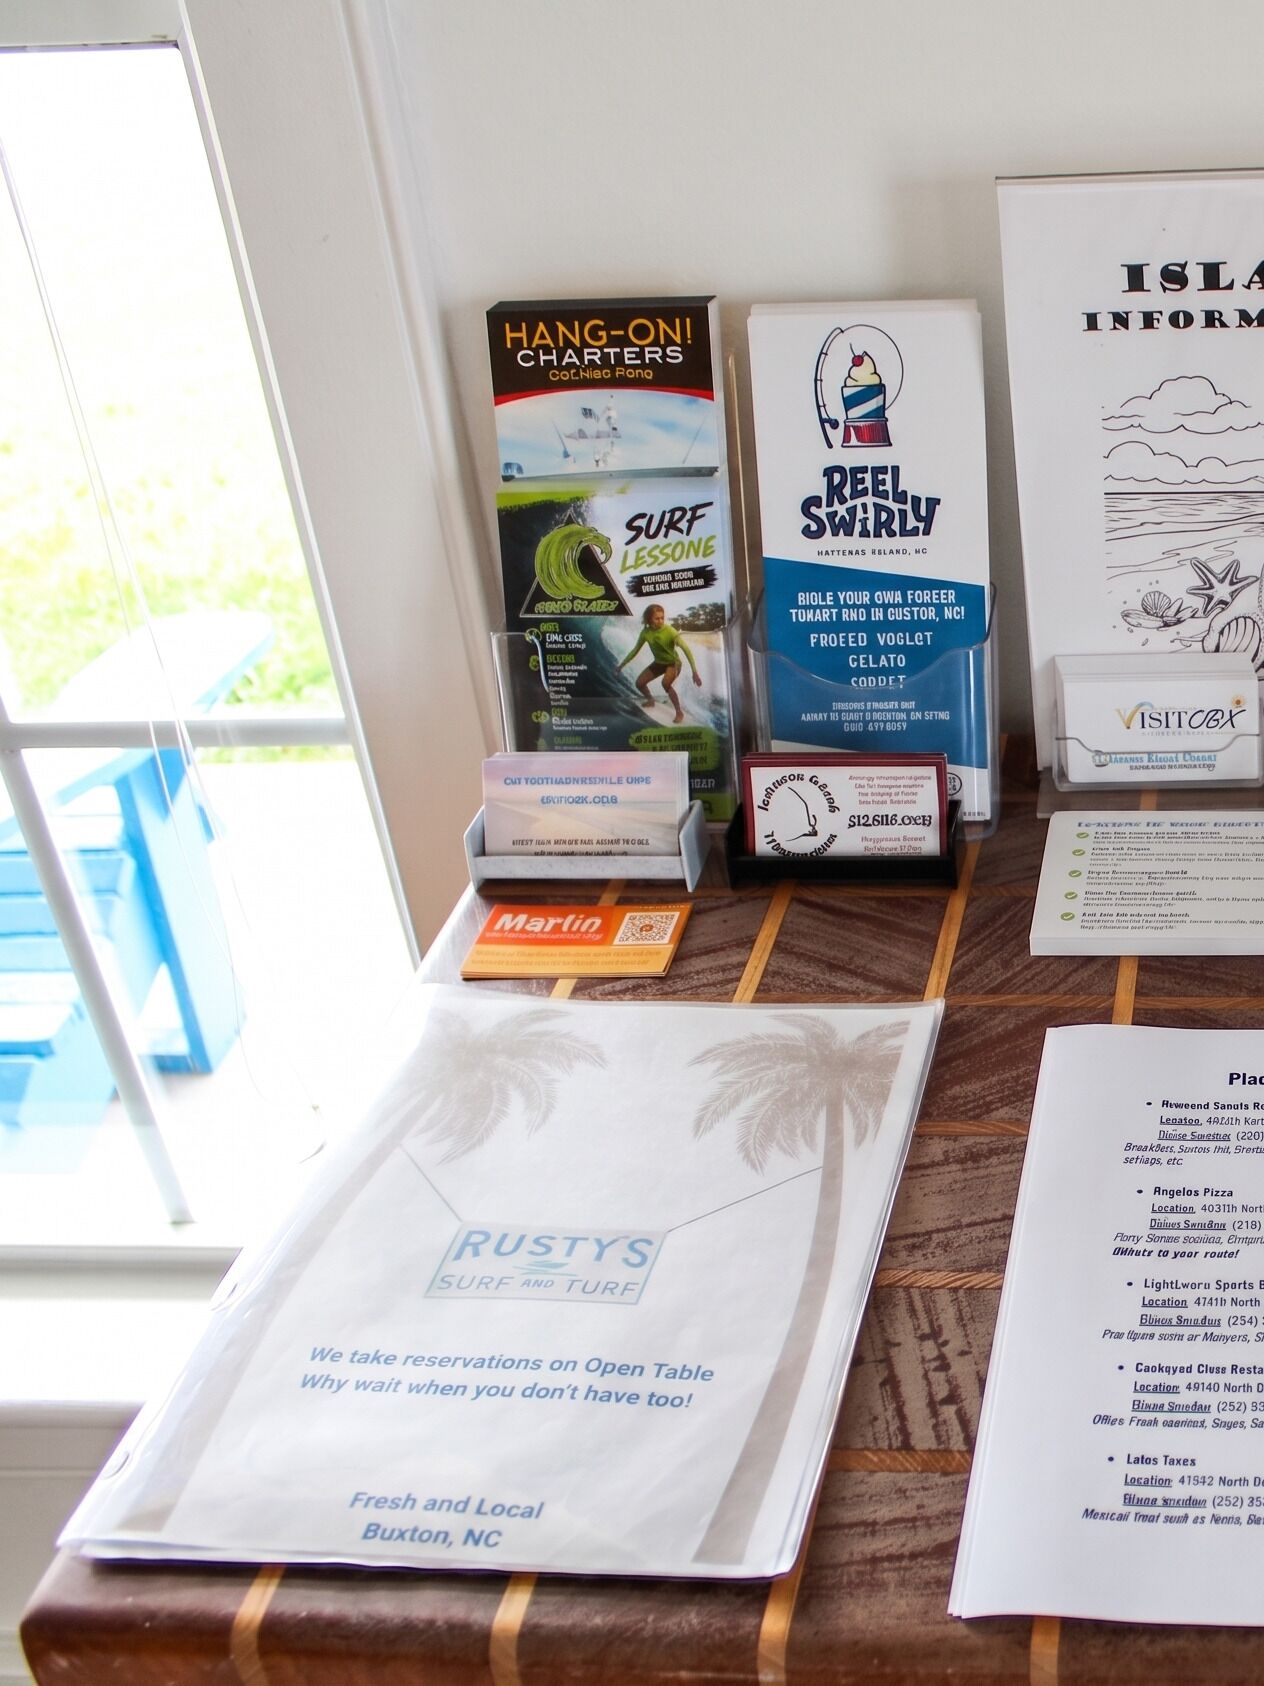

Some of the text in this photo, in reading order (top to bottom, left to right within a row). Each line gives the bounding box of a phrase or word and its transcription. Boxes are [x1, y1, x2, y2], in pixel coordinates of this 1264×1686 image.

[505, 318, 692, 348] HANG-ON!
[517, 346, 683, 367] CHARTERS
[823, 465, 908, 507] REEL
[624, 501, 713, 545] SURF
[839, 592, 870, 604] YOUR
[907, 590, 956, 603] FOREER
[944, 606, 965, 620] NC!
[493, 913, 602, 933] Marlin
[1153, 1187, 1234, 1199] Angelos Pizza
[437, 1275, 639, 1296] SURF AND TURF
[1231, 1297, 1261, 1307] North
[1227, 1315, 1258, 1327] (254)
[309, 1347, 714, 1381] We take reservations on Open Table
[300, 1374, 693, 1408] Why wait when you don't have too!
[1223, 1382, 1253, 1393] North
[1217, 1402, 1247, 1414] (252)
[1163, 1455, 1196, 1466] Taxes
[1219, 1476, 1249, 1487] North
[349, 1491, 545, 1520] Fresh and Local
[1212, 1496, 1243, 1509] (252)
[361, 1522, 503, 1548] Buxton, NC
